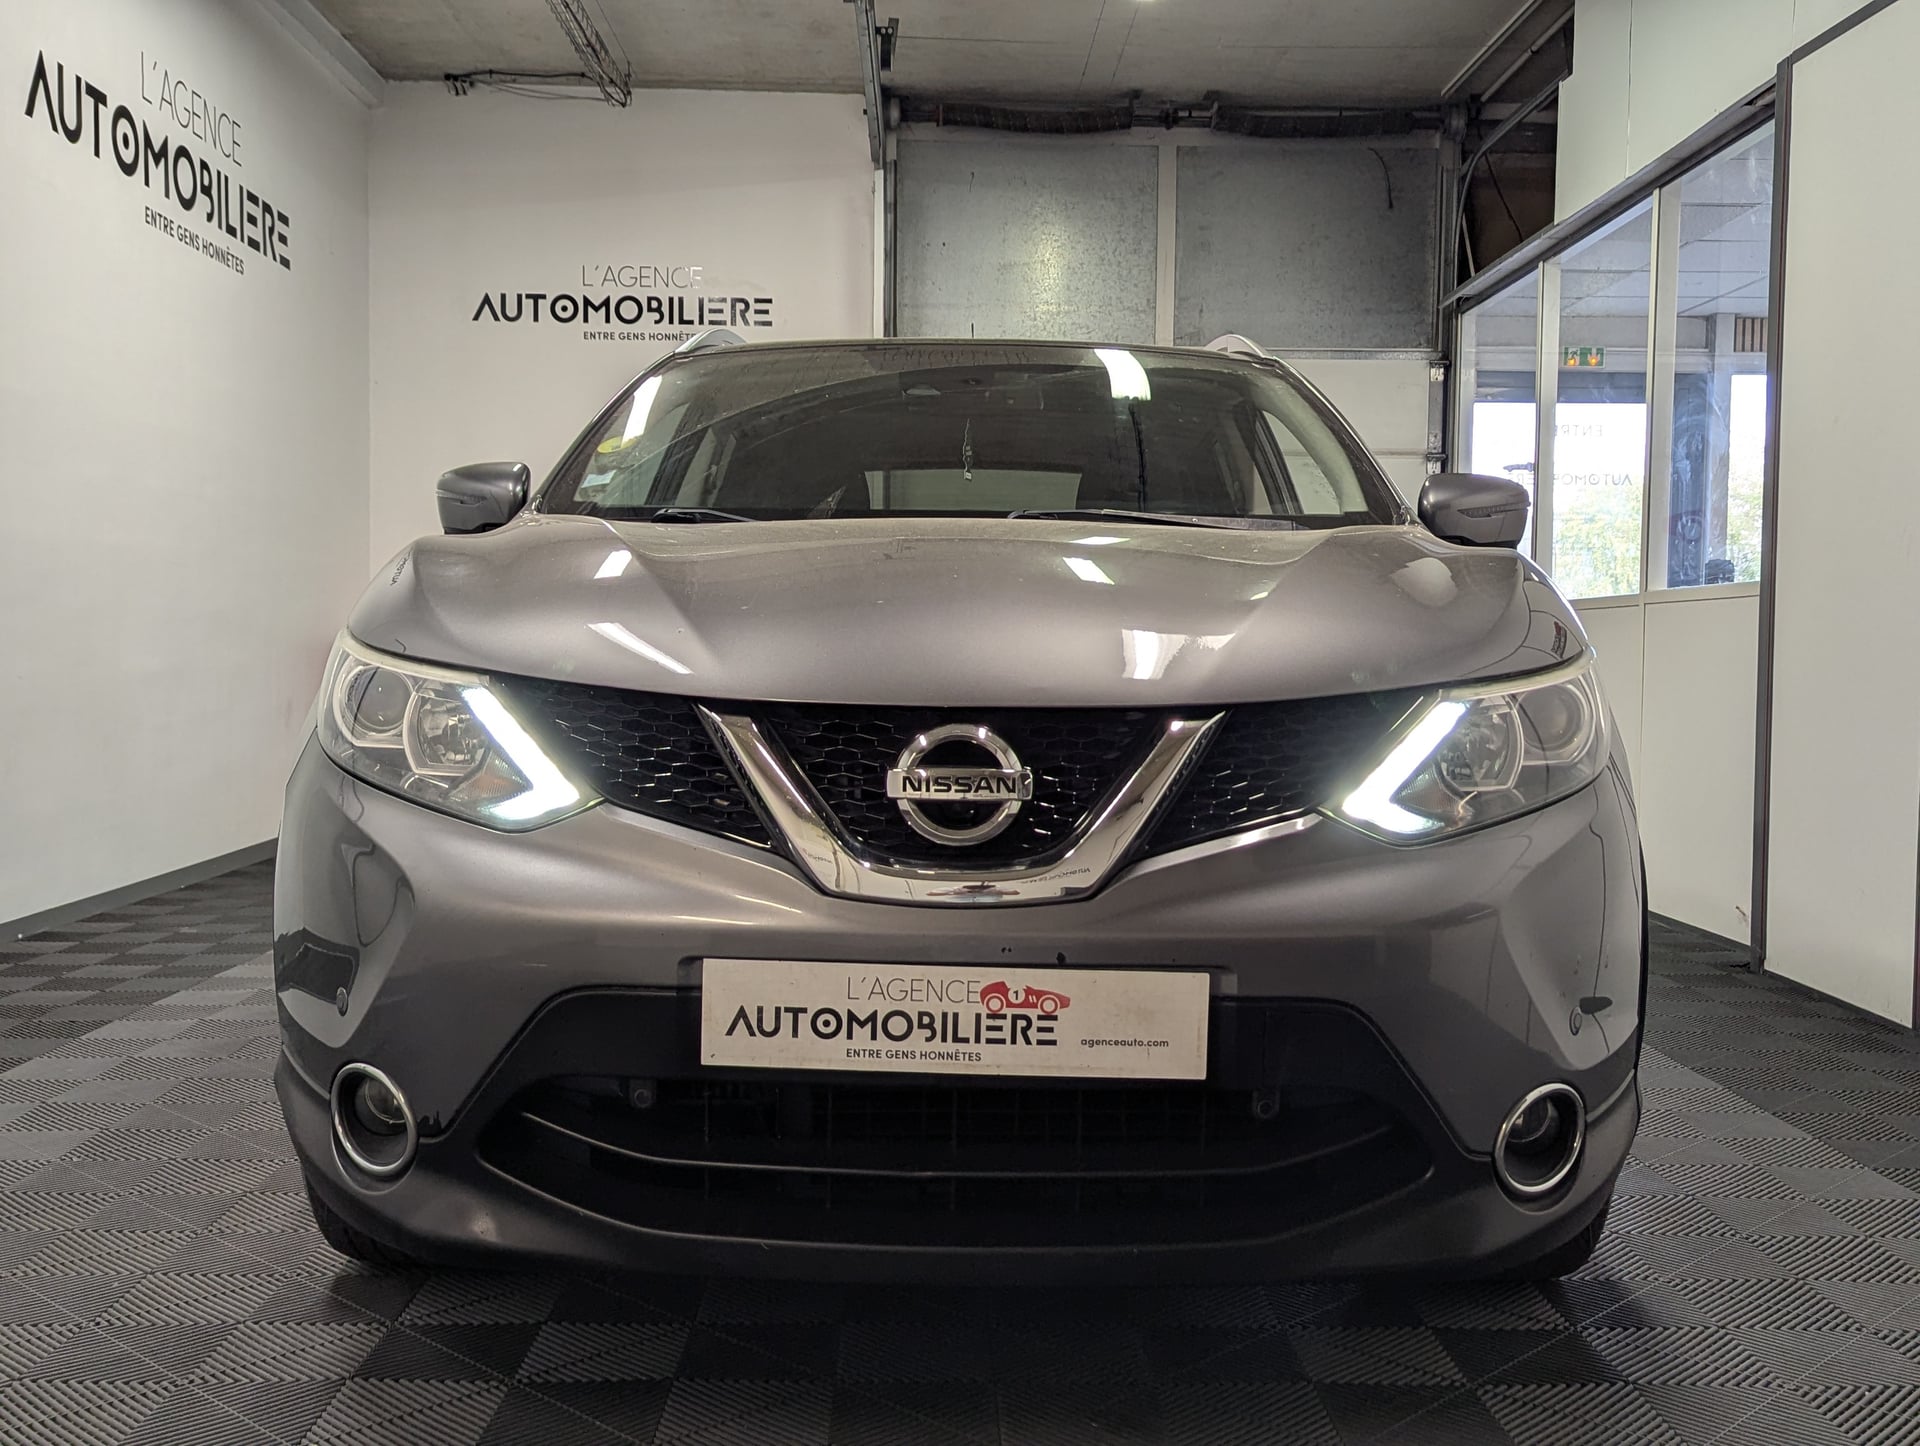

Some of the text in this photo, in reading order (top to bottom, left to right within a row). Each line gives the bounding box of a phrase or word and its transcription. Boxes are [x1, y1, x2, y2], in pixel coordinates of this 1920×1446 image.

[141, 51, 242, 167] L'AGENCE
[24, 49, 291, 271] AUTOMOBILIERE
[145, 205, 175, 237] ENTRE
[177, 224, 200, 252] GENS
[472, 292, 773, 326] AUTOMOBILIERE
[583, 331, 616, 341] ENTRE
[618, 332, 646, 341] GENS
[903, 775, 1017, 794] NISSAN
[847, 976, 1019, 1004] L'AGENCE 1
[725, 1004, 1058, 1047] AUTOMOBILIERE
[846, 1048, 982, 1062] ENTRE GENS HONNÊTES
[1080, 1037, 1169, 1048] agenceauto.com
